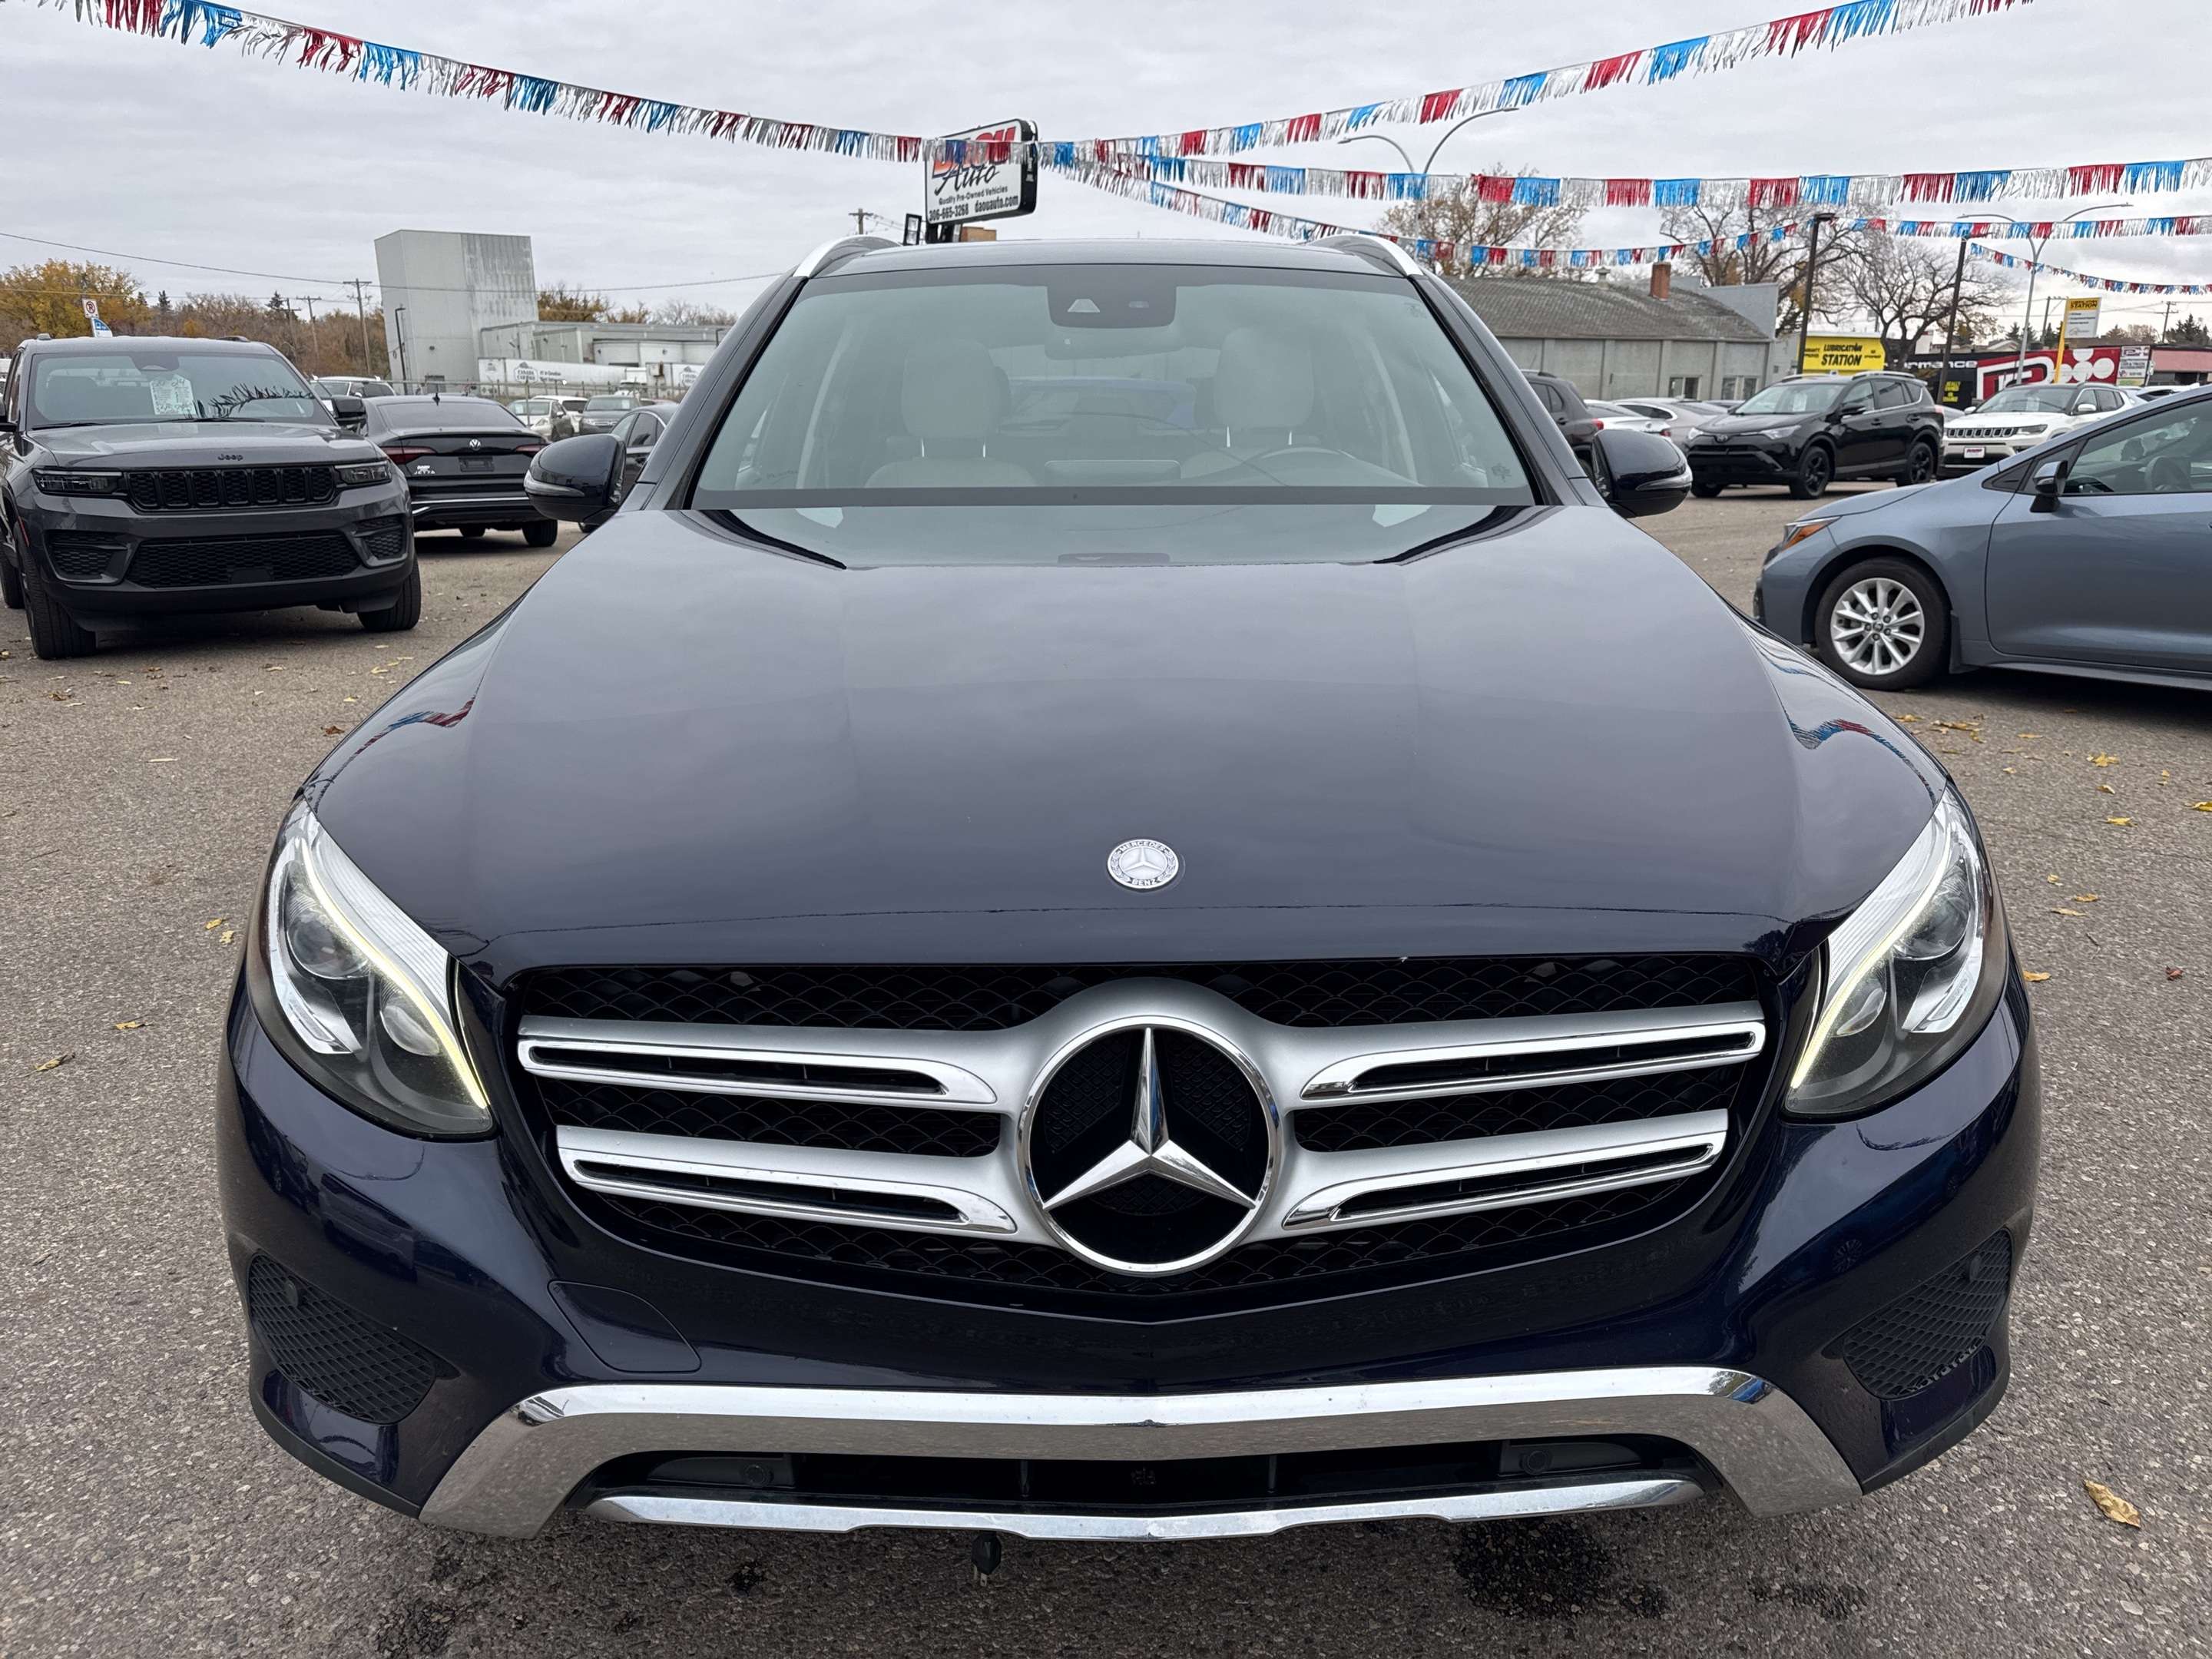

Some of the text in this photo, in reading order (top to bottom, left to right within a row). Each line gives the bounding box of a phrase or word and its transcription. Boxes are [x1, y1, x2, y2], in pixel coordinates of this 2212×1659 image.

[1823, 343, 1863, 352] LUBRICATION
[1821, 354, 1862, 366] STATION
[1119, 841, 1165, 852] MERCEDES
